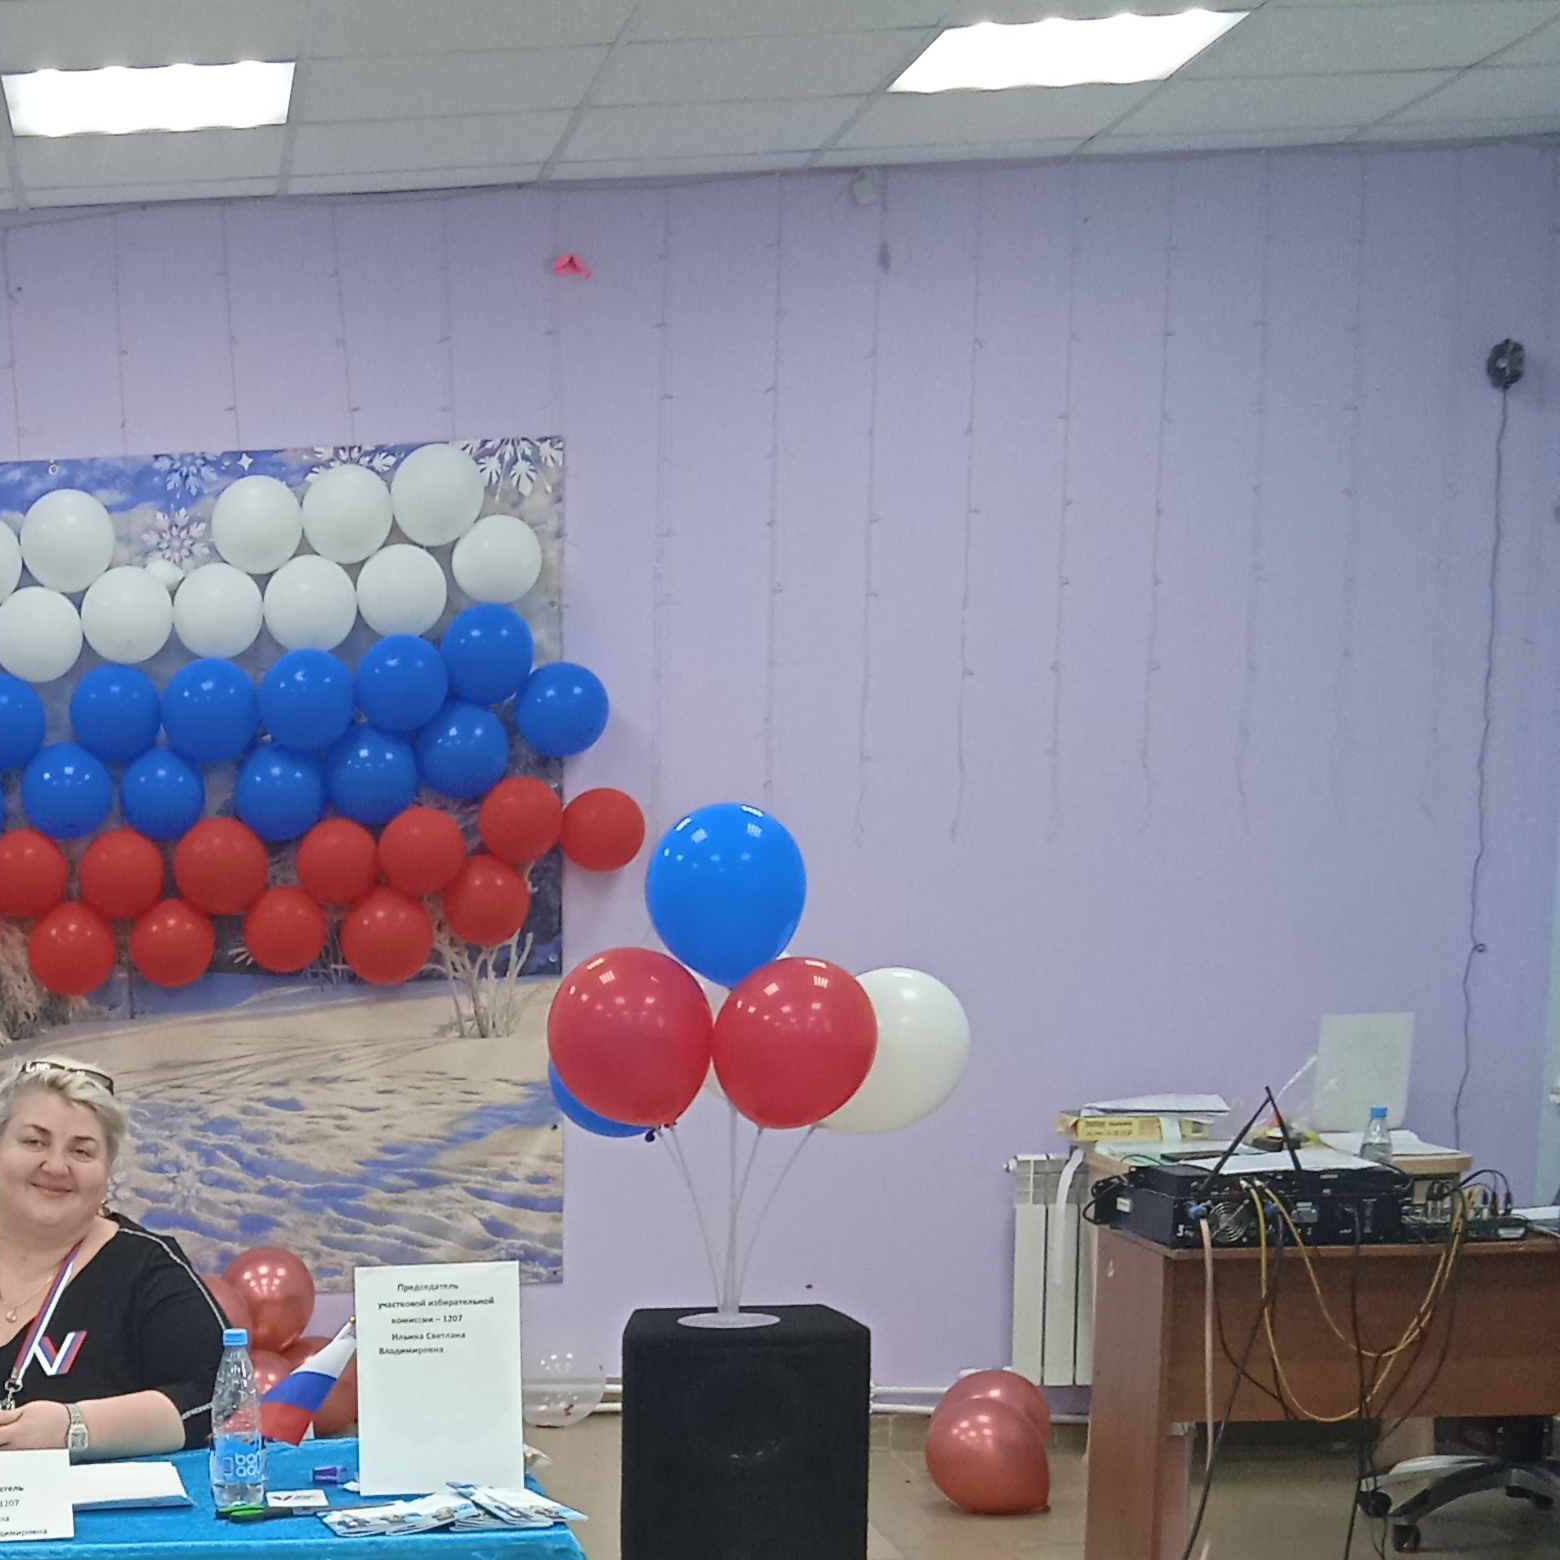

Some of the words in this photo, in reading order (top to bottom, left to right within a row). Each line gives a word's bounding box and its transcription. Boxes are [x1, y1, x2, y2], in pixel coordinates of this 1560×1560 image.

[397, 1283, 459, 1293] Председатель
[378, 1299, 426, 1310] участковой
[428, 1296, 494, 1307] избирательной
[443, 1314, 463, 1323] 1207
[391, 1333, 424, 1341] Ильина
[426, 1332, 466, 1340] Светлана
[236, 1465, 261, 1477] aqu
[0, 1499, 20, 1508] 1207
